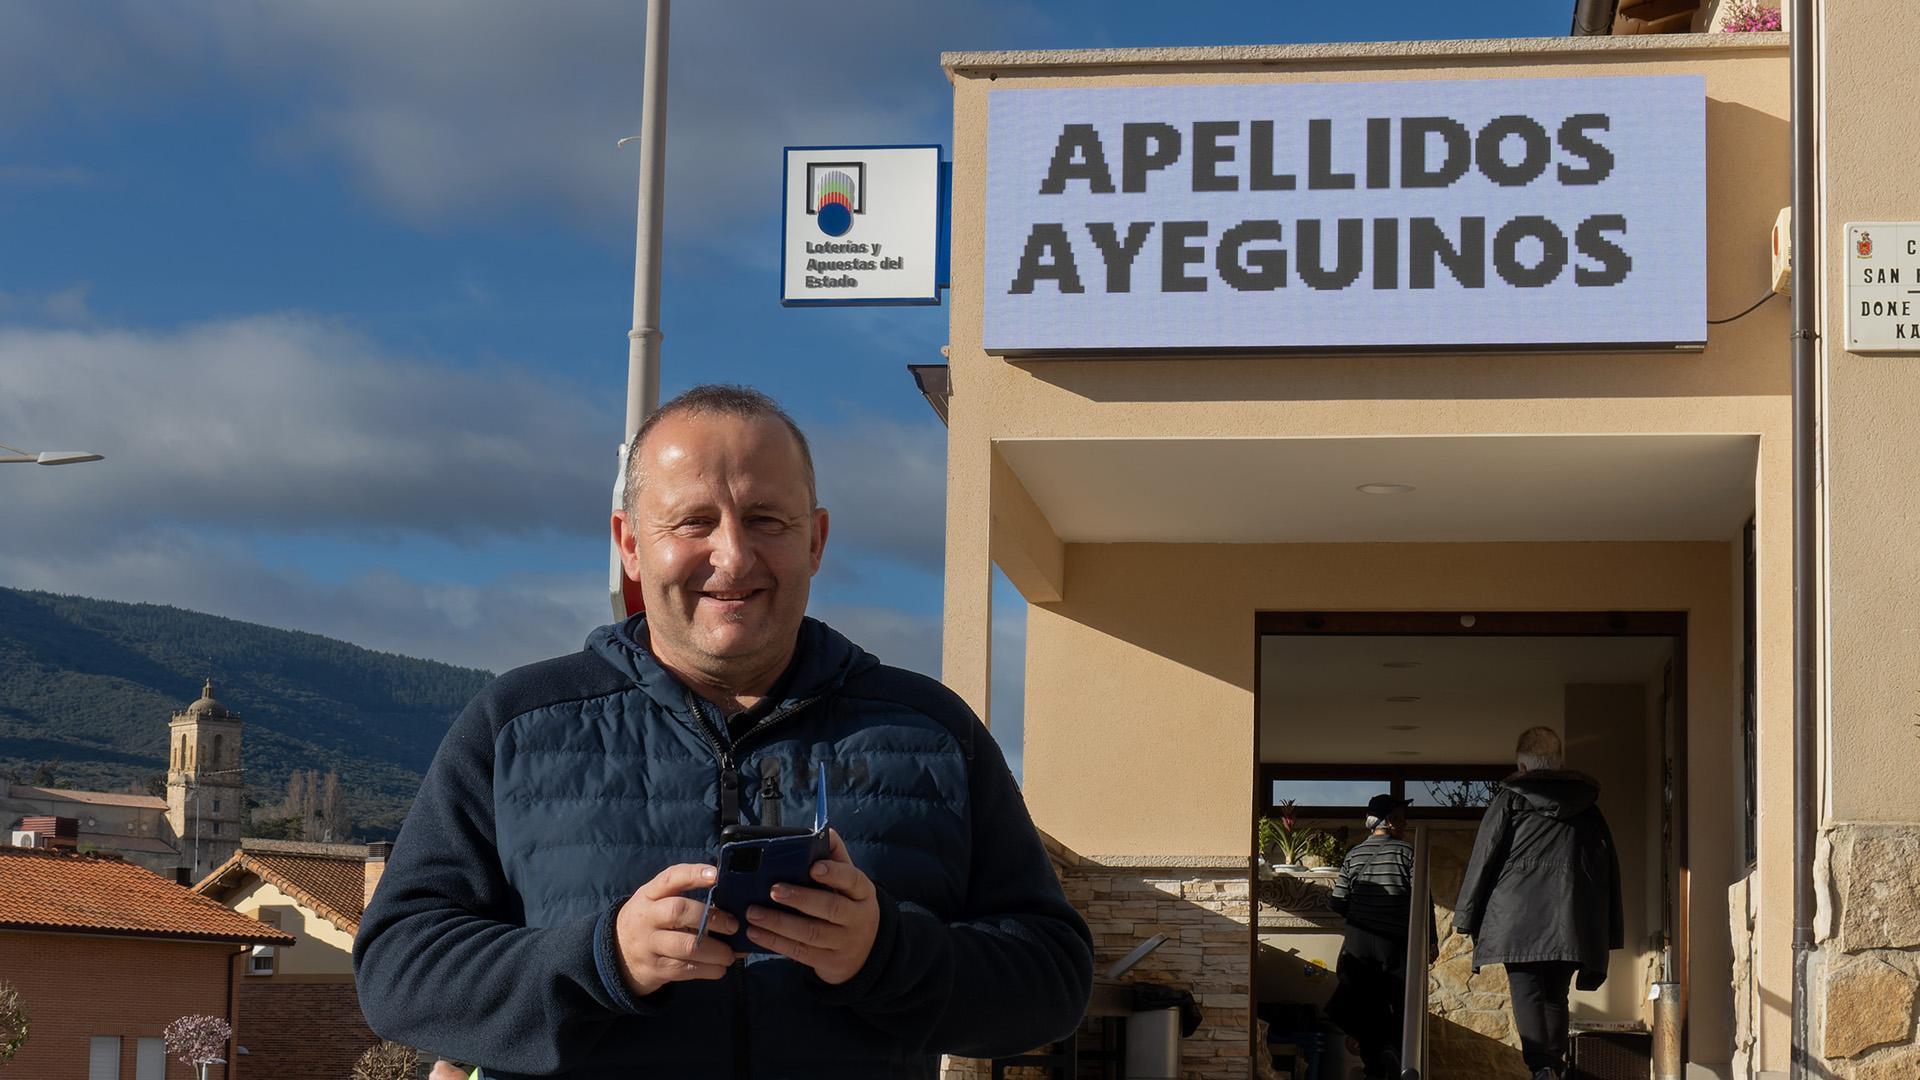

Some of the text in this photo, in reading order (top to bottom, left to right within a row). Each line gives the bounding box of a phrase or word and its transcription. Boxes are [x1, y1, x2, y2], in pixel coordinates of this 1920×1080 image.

[1039, 113, 1615, 194] APELLIDOS
[806, 240, 882, 257] Loterías y
[1007, 214, 1632, 294] AYEGUINOS
[806, 256, 903, 274] Apuestas del
[805, 274, 858, 288] Estado
[1863, 268, 1900, 284] SAN
[1861, 301, 1911, 316] DONE
[1896, 323, 1920, 339] KA
